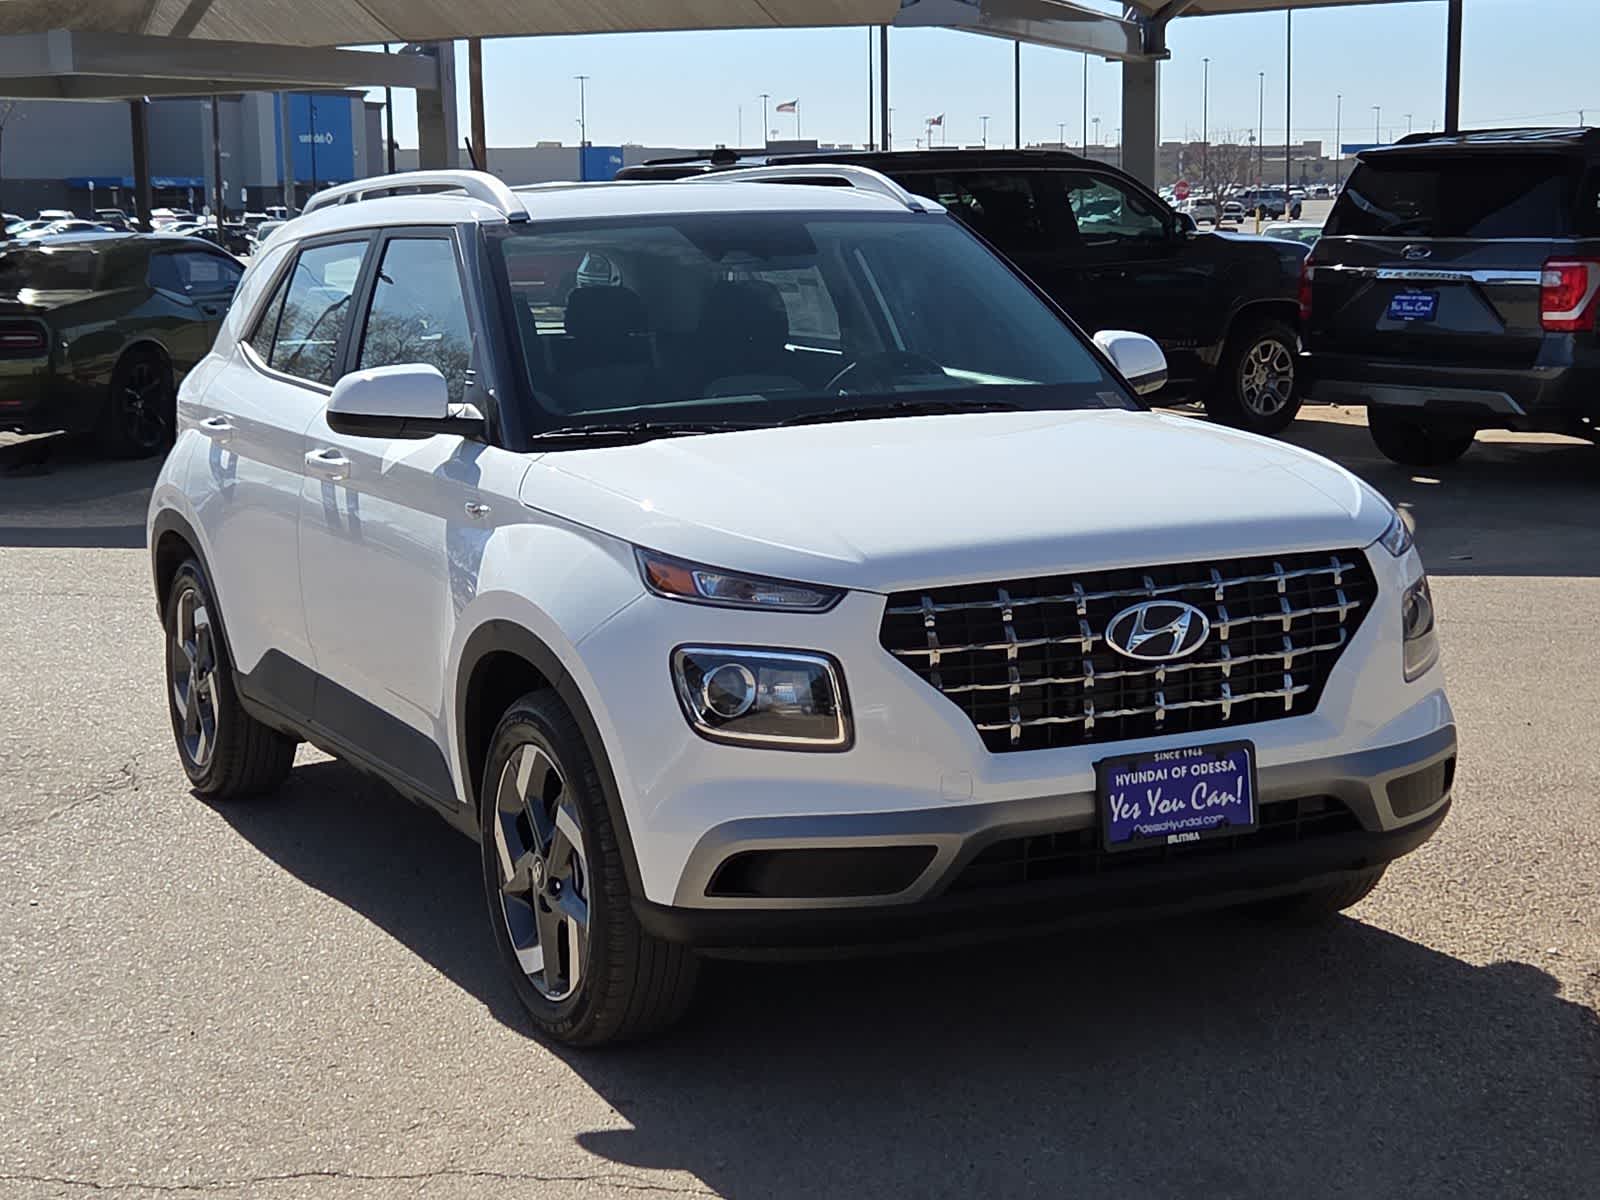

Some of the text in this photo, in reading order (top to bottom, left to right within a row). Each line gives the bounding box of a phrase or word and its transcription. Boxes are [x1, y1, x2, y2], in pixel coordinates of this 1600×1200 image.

[1153, 751, 1180, 762] SINCE
[1115, 760, 1237, 787] HYUNDAI OF ODESSA
[1110, 775, 1243, 822] Yes You Can!
